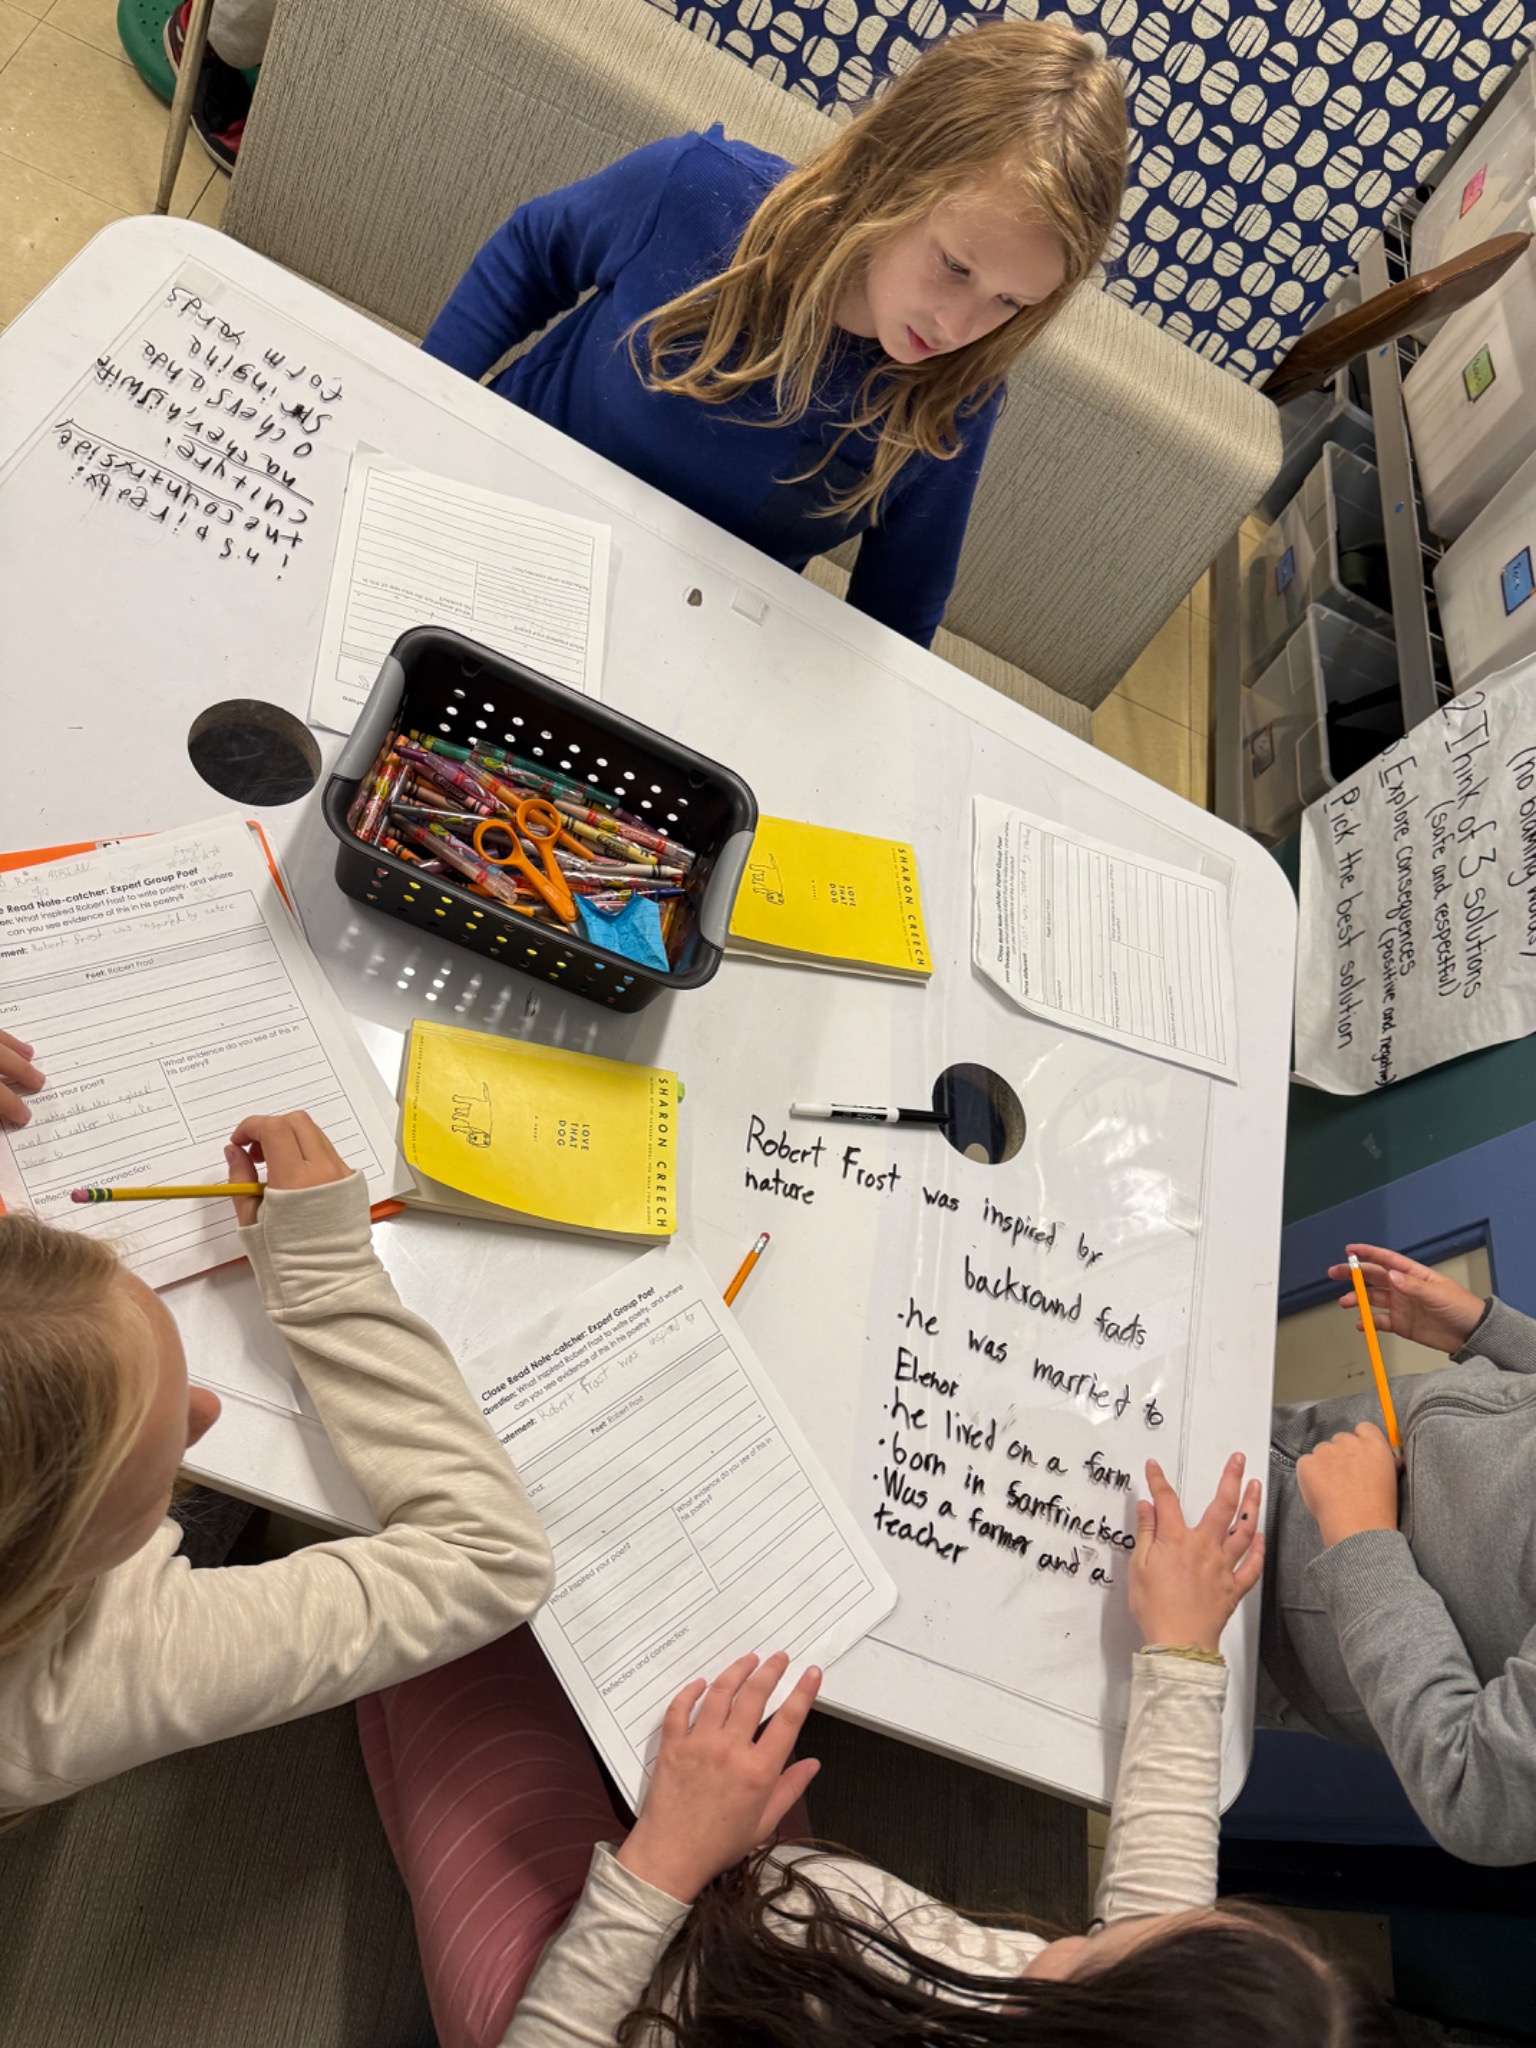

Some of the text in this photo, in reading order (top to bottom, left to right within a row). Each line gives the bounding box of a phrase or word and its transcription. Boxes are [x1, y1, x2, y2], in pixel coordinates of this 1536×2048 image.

[244, 515, 304, 549] the
[1379, 755, 1419, 842] Explore
[1441, 691, 1499, 1000] 2. Think of 3 solutions
[7, 903, 34, 913] Read
[111, 880, 141, 893] Expert
[144, 875, 174, 886] Group
[176, 868, 198, 878] Poet
[15, 914, 39, 923] What
[40, 907, 75, 918] inspired
[76, 900, 105, 911] Robert
[106, 896, 125, 905] Frost
[190, 877, 207, 887] and
[208, 872, 233, 881] where
[27, 926, 44, 934] you
[63, 913, 104, 926] evidence
[153, 894, 184, 907] poetry?
[829, 882, 838, 904] DOG
[838, 885, 848, 906] THAT
[847, 886, 856, 908] LOVE
[898, 848, 914, 905] SHARON
[908, 914, 925, 966] CREECH
[1323, 785, 1364, 1050] Pick the best solution
[1386, 842, 1417, 977] consequences
[1425, 799, 1461, 998] (safe and respectful)
[1378, 926, 1399, 1004] (positive
[1382, 1007, 1397, 1034] and
[557, 1120, 568, 1147] DOG
[569, 1122, 579, 1150] THAT
[580, 1124, 591, 1151] LOVE
[656, 1077, 669, 1228] SHARON CREECH
[744, 1168, 816, 1205] nature
[745, 1114, 827, 1168] Robert
[842, 1145, 902, 1193] Frost
[922, 1186, 960, 1213] was
[983, 1198, 1057, 1249] inspired
[963, 1255, 1082, 1322] backround
[482, 1383, 506, 1401] Close
[507, 1366, 530, 1384] Read
[588, 1313, 613, 1333] Expert
[614, 1300, 638, 1316] Group
[638, 1287, 654, 1302] Poet
[483, 1392, 517, 1415] Question:
[516, 1378, 537, 1393] What
[537, 1360, 565, 1380] inspired
[564, 1345, 588, 1363] Robert
[587, 1335, 604, 1348] Frost
[611, 1320, 628, 1332] write
[651, 1296, 664, 1308] and
[664, 1284, 683, 1299] where
[514, 1398, 530, 1410] can
[529, 1389, 544, 1402] you
[544, 1380, 557, 1391] see
[557, 1358, 590, 1382] evidence
[598, 1345, 610, 1355] this
[536, 1391, 576, 1422] Robert
[578, 1364, 611, 1394] Frost
[617, 1350, 640, 1369] was
[968, 1329, 1009, 1363] was
[1033, 1357, 1131, 1418] married
[1144, 1398, 1165, 1427] to
[607, 1406, 628, 1423] Robert
[628, 1395, 644, 1407] Frost
[946, 1409, 996, 1450] lived
[1007, 1440, 1038, 1466] on
[1046, 1456, 1068, 1475] a
[1084, 1451, 1132, 1491] farm
[964, 1464, 985, 1495] in
[676, 1498, 692, 1513] What
[694, 1478, 720, 1500] evidence
[729, 1463, 740, 1473] you
[740, 1455, 750, 1465] see
[681, 1513, 690, 1521] his
[873, 1502, 969, 1564] teacher
[938, 1500, 957, 1519] a
[1037, 1546, 1081, 1576] and
[1090, 1567, 1113, 1586] a
[548, 1542, 631, 1605] What inspired your poet?
[602, 1668, 635, 1696] Reflection
[636, 1655, 650, 1670] and
